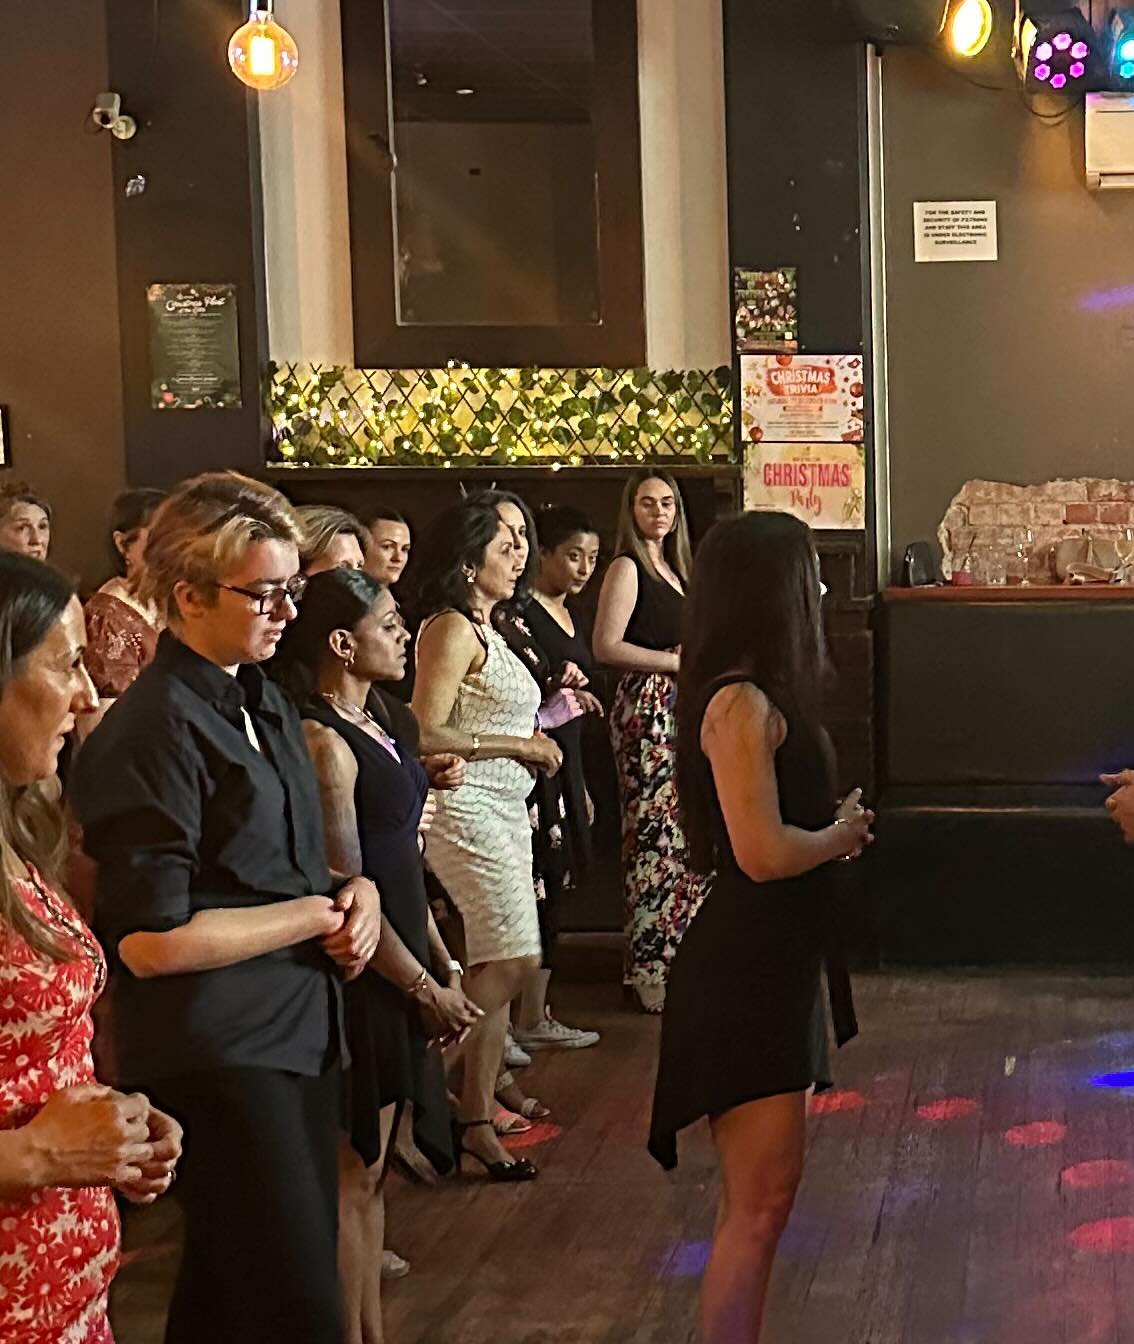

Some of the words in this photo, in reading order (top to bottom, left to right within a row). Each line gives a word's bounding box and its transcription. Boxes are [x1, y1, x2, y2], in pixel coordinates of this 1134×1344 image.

[770, 369, 831, 385] CHRISTMAS
[784, 384, 818, 394] TRIVIA
[763, 463, 850, 487] CHRISTMAS
